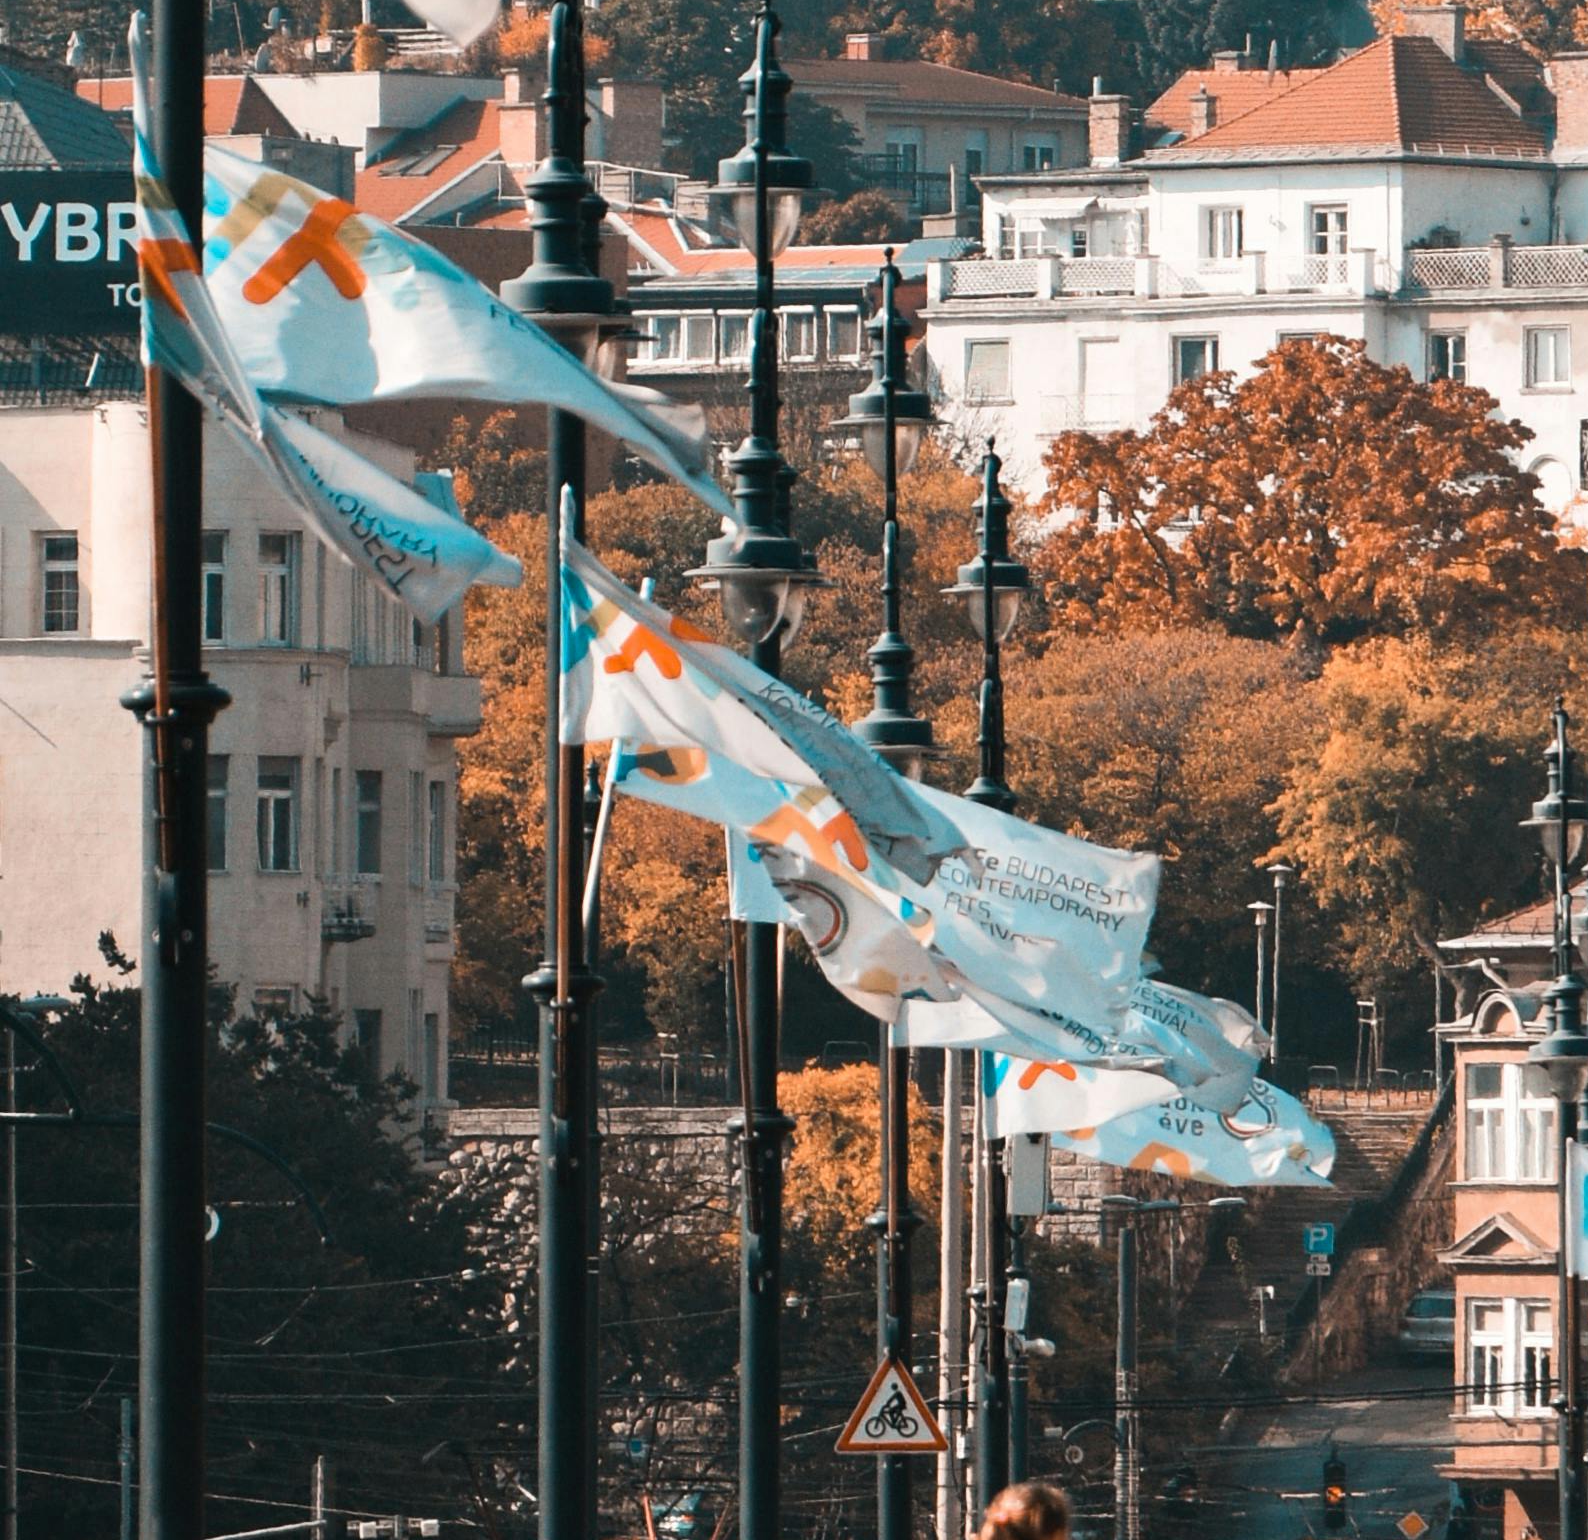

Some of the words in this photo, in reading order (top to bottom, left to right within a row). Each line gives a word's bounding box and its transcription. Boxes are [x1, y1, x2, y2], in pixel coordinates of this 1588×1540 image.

[938, 862, 1126, 932] CONTEMPORARY
[1006, 856, 1128, 907] BUDAPEST
[1158, 1112, 1205, 1137] éve
